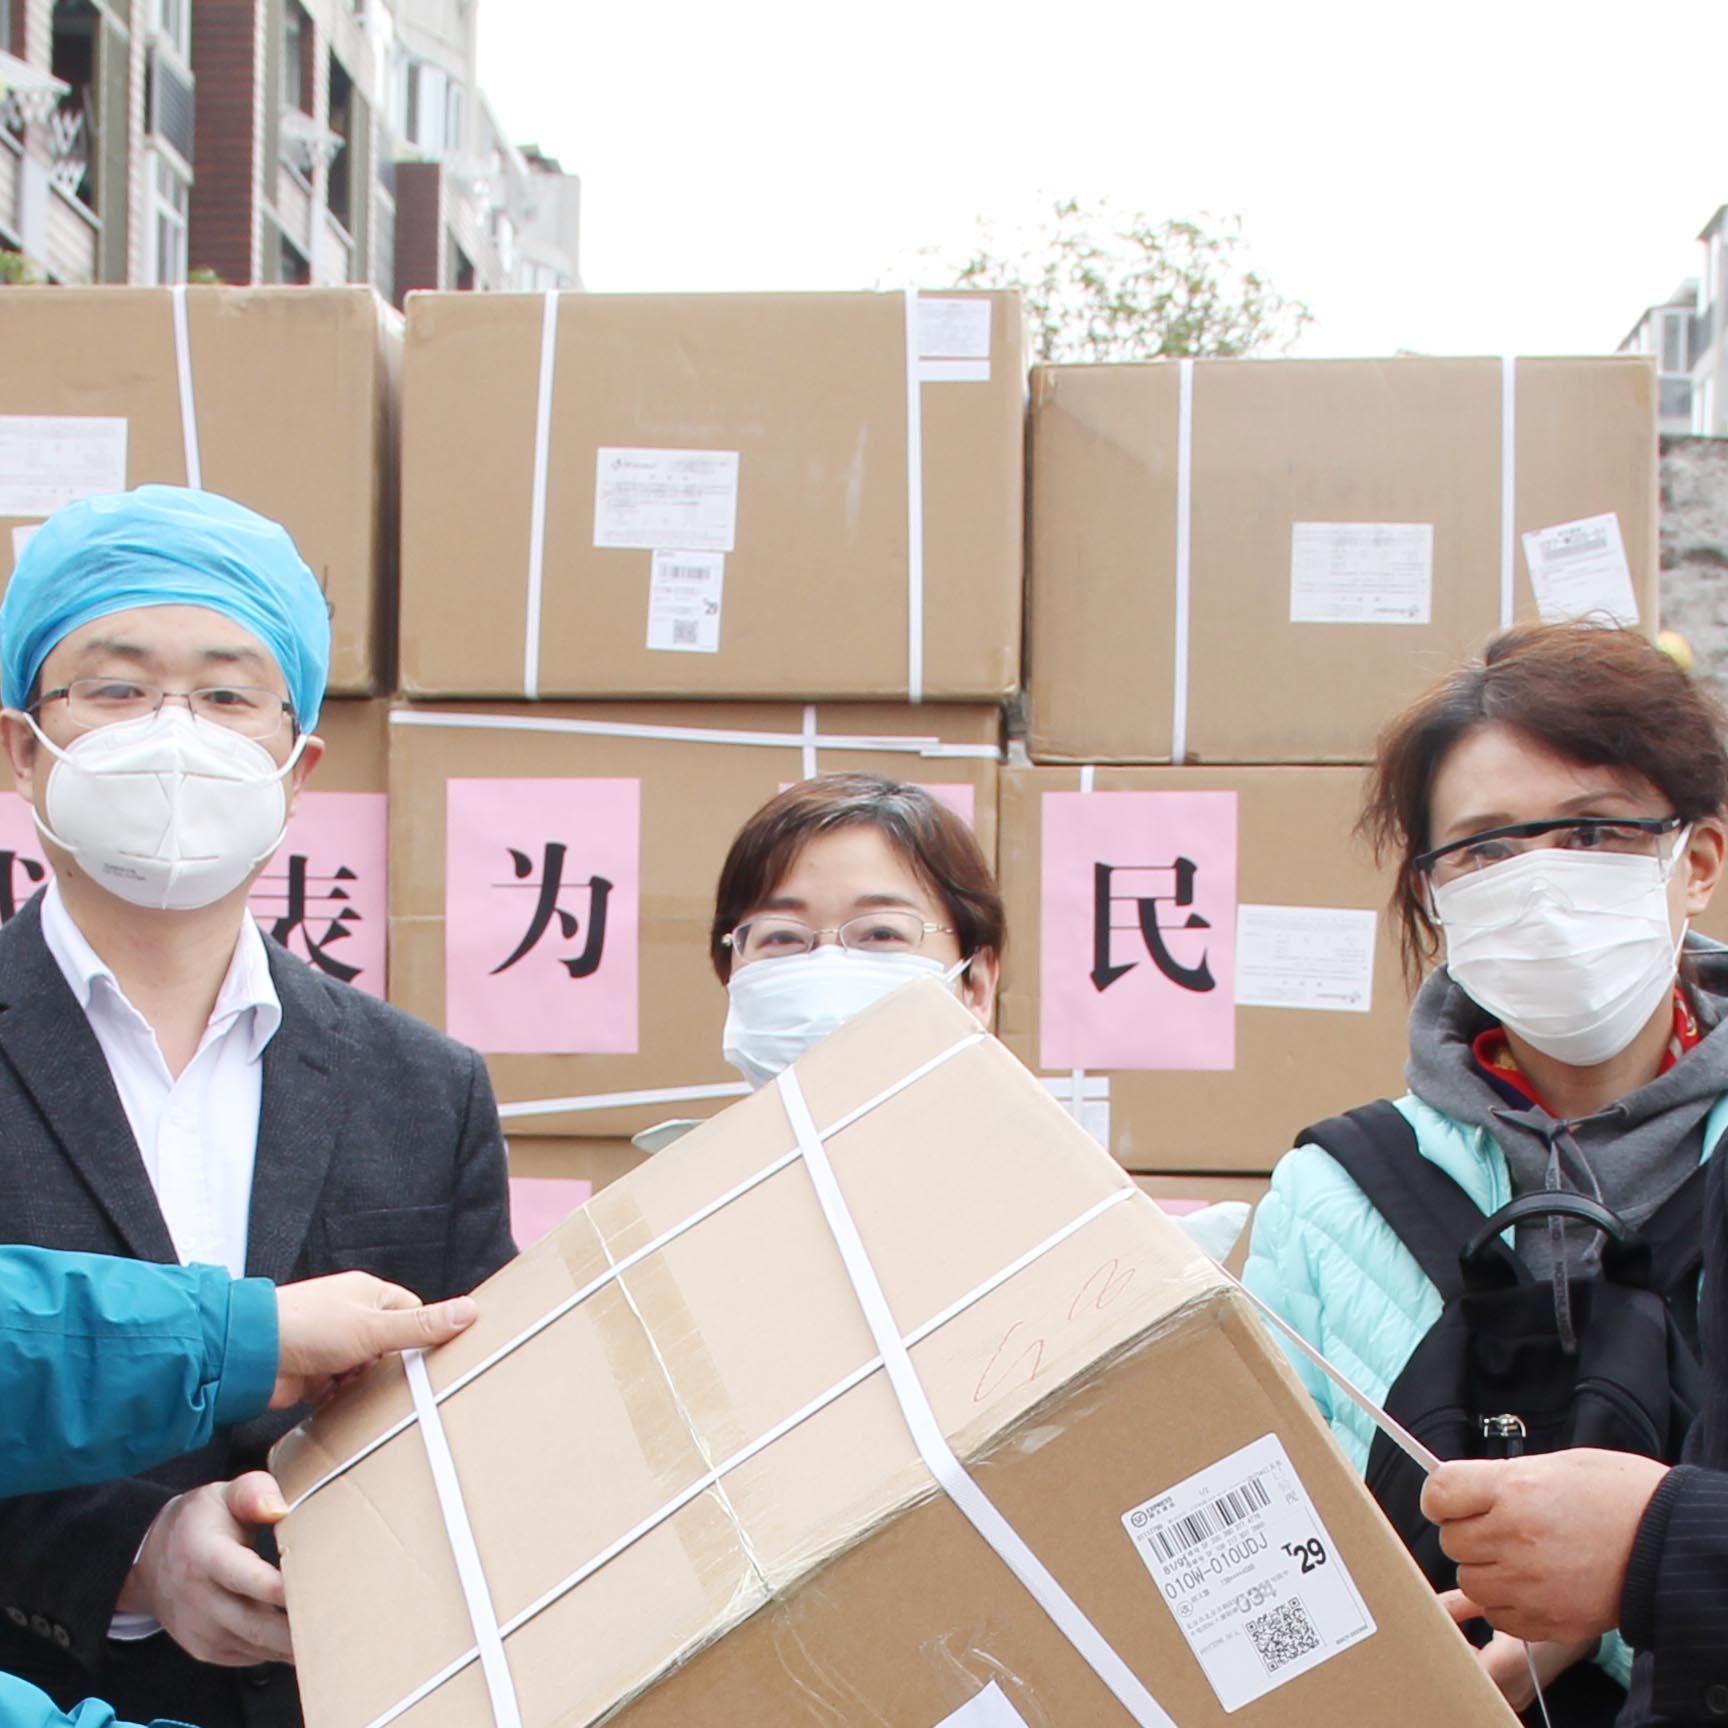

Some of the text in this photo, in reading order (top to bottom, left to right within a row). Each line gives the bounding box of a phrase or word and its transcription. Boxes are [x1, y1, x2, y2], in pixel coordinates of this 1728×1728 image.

[249, 855, 363, 983] 表
[491, 842, 614, 979] 为
[1089, 856, 1216, 994] 民
